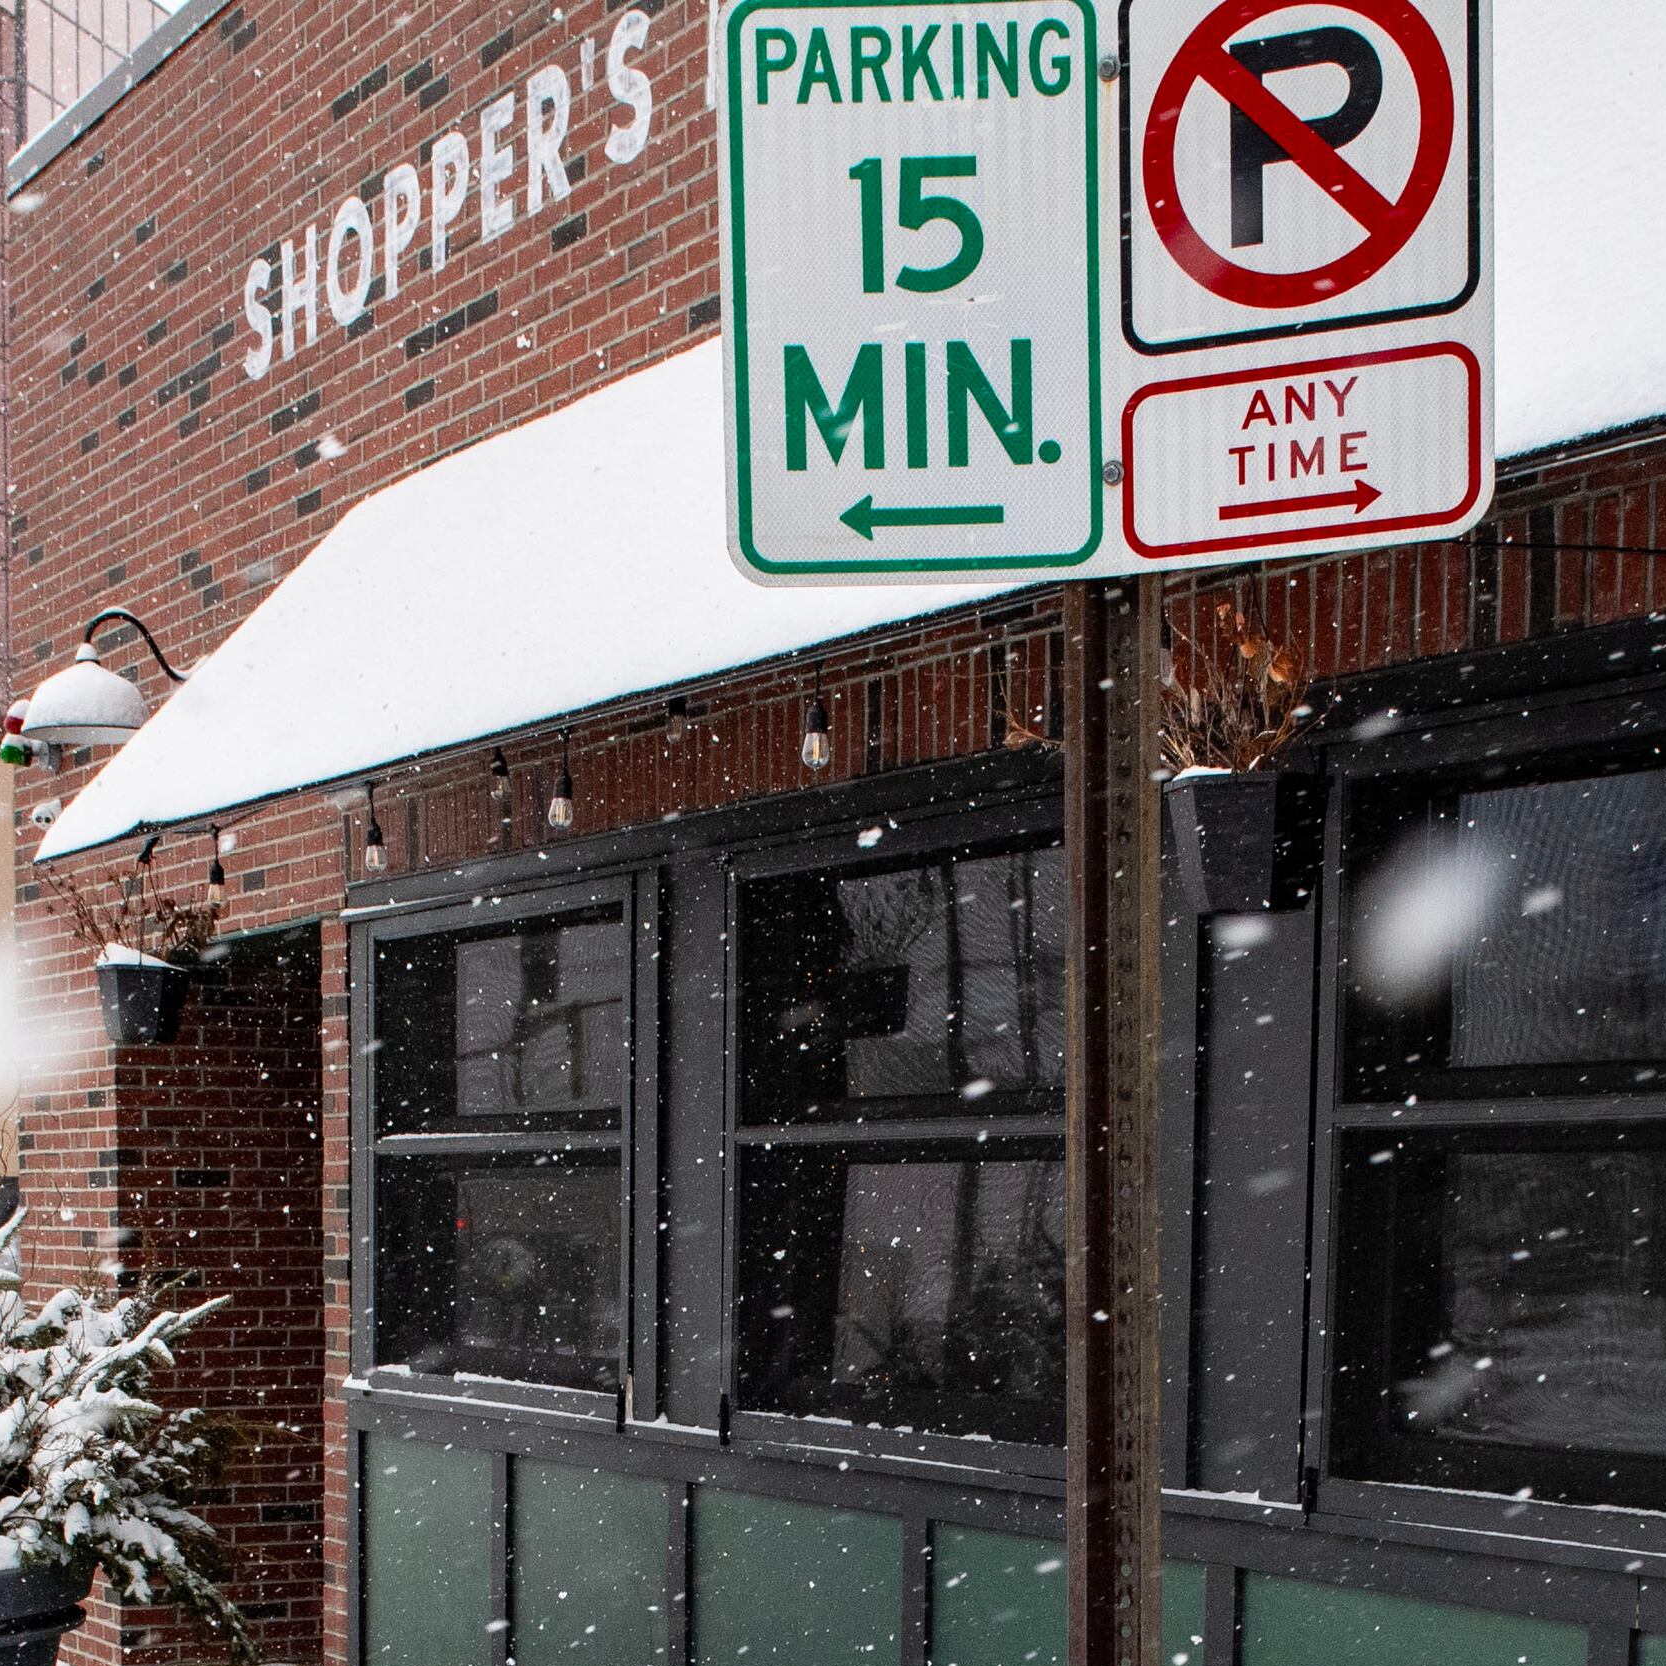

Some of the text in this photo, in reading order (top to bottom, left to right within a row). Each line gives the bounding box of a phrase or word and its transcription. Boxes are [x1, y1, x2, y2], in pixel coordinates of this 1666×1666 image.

[755, 18, 1071, 104] PARKING
[243, 10, 652, 380] SHOPPER'S
[849, 155, 984, 293] 15
[784, 338, 1061, 471] MIN.
[1241, 376, 1358, 430] ANY
[1229, 431, 1367, 485] TIME
